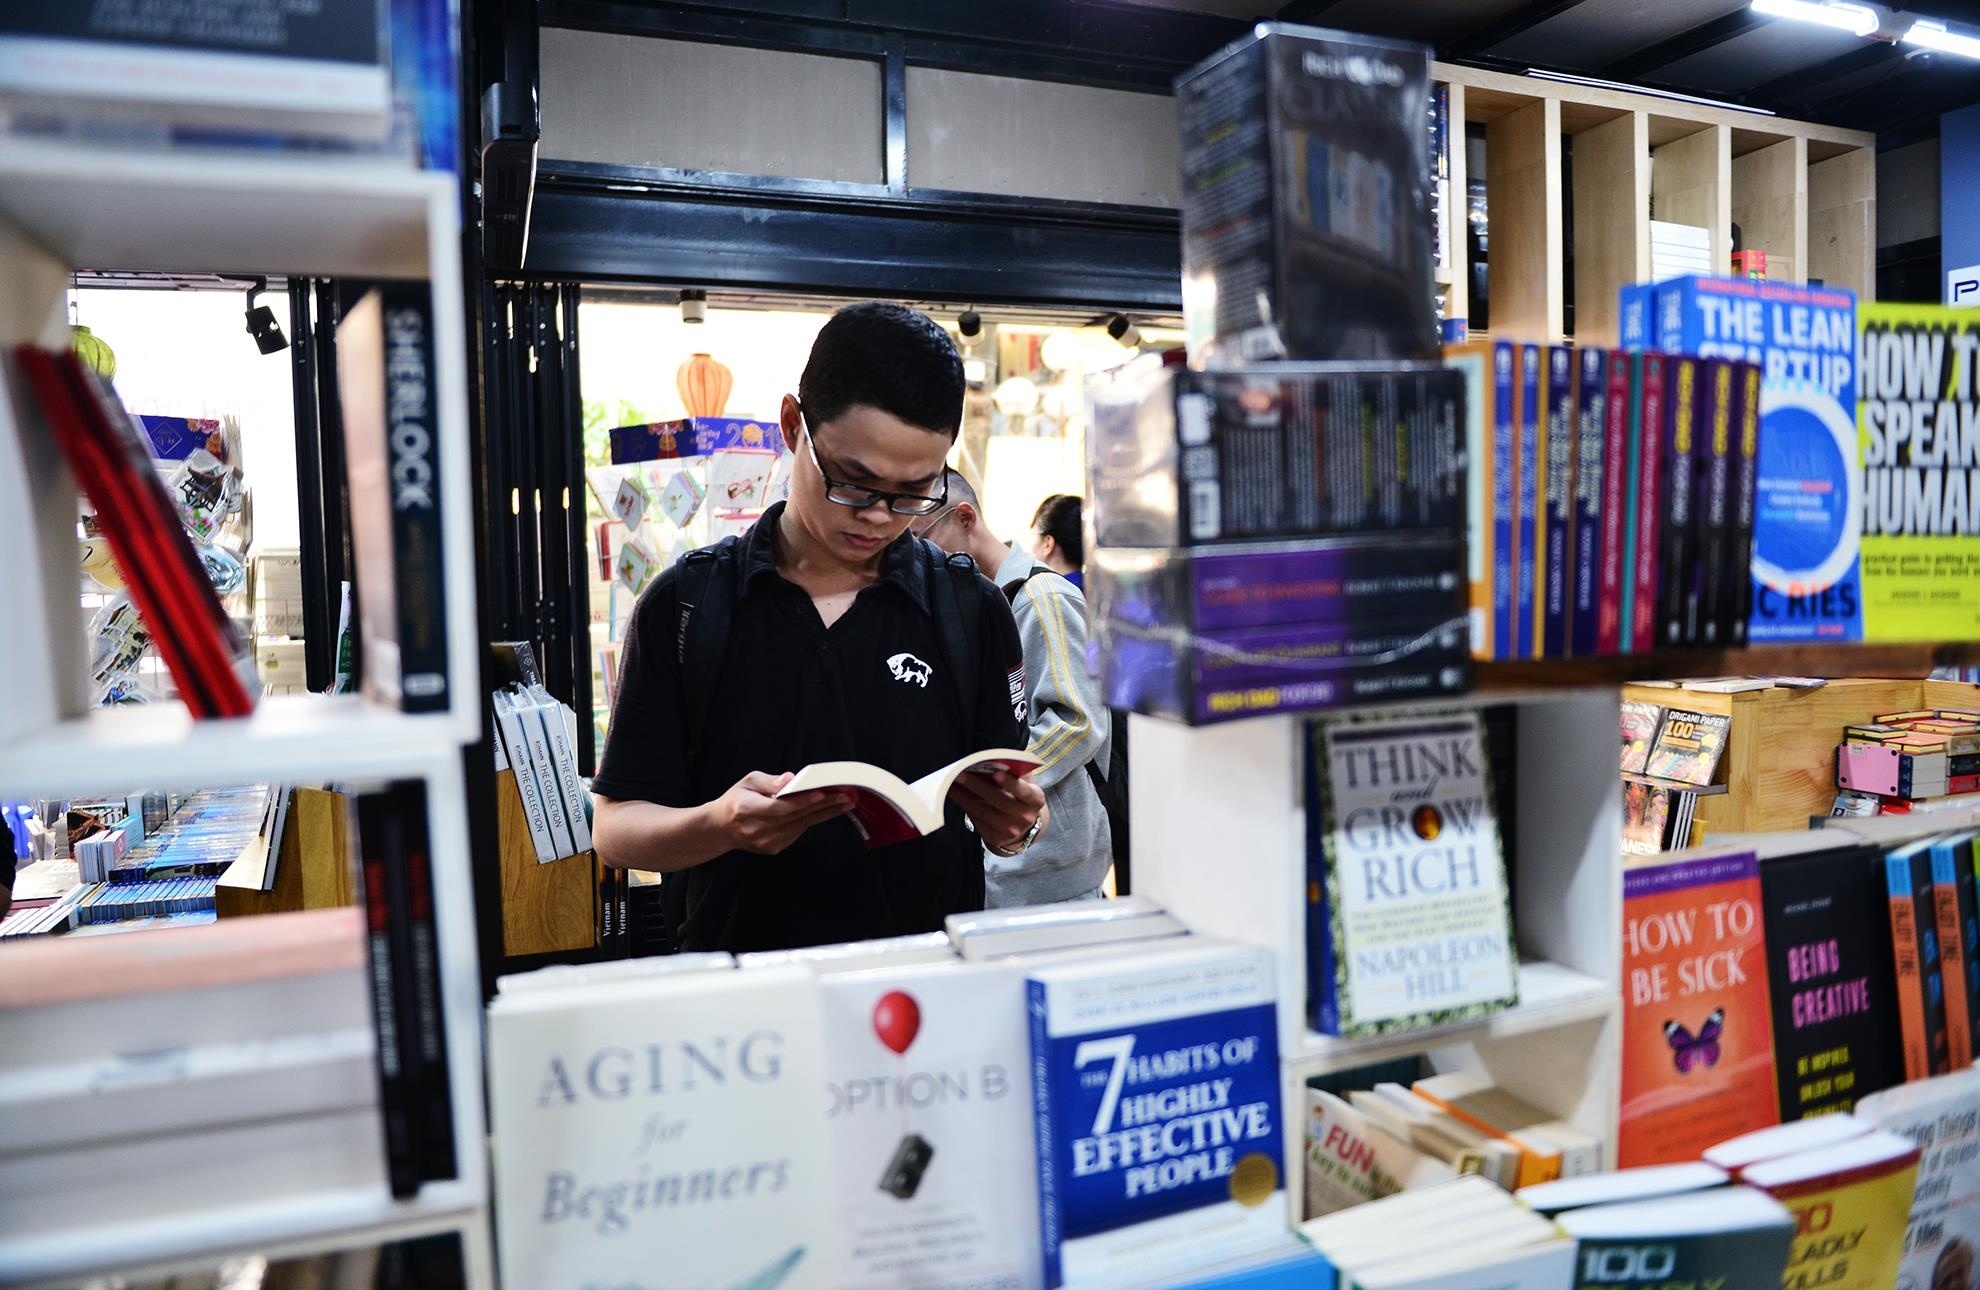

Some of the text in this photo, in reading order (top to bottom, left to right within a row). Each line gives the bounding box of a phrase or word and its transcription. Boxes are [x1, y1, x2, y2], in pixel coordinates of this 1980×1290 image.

[1696, 295, 1852, 354] THE LEAN
[1857, 330, 1945, 400] HOW
[387, 309, 433, 511] SHERLOCK
[1864, 399, 1980, 468] SPEAK
[1788, 580, 1857, 619] RIES
[1665, 720, 1694, 739] 100
[1669, 711, 1726, 728] ORIGAMI PAPER
[521, 768, 532, 783] THE
[541, 764, 552, 779] THE
[561, 758, 572, 773] THE
[1335, 738, 1478, 789] THINK
[525, 784, 544, 833] COLLECTION
[544, 779, 562, 828] COLLECTION
[565, 774, 582, 823] COLLECTION
[1345, 796, 1484, 853] GROW
[1362, 845, 1480, 902] RICH
[603, 902, 611, 937] Vietnam
[618, 901, 626, 936] Vietnam
[1623, 897, 1755, 958] HOW TO
[1357, 932, 1500, 981] NAPOLEON
[1631, 945, 1747, 1007] BE SICK
[1788, 938, 1840, 984] BEING
[1405, 968, 1470, 1001] HILL
[1792, 976, 1870, 1029] CREATIVE
[537, 1029, 786, 1109] AGING
[979, 1063, 1011, 1101] B
[1073, 1033, 1137, 1135] 7
[1125, 1041, 1221, 1085] HABITS
[1222, 1035, 1260, 1067] OF
[1120, 1076, 1234, 1129] HIGHLY
[1938, 1110, 1977, 1138] Things
[634, 1112, 694, 1156] for
[1072, 1100, 1272, 1178] EFFECTIVE
[1324, 1122, 1377, 1175] FUN
[1124, 1145, 1237, 1200] PEOPLE
[540, 1157, 794, 1239] Beginners
[1583, 1245, 1677, 1282] 100
